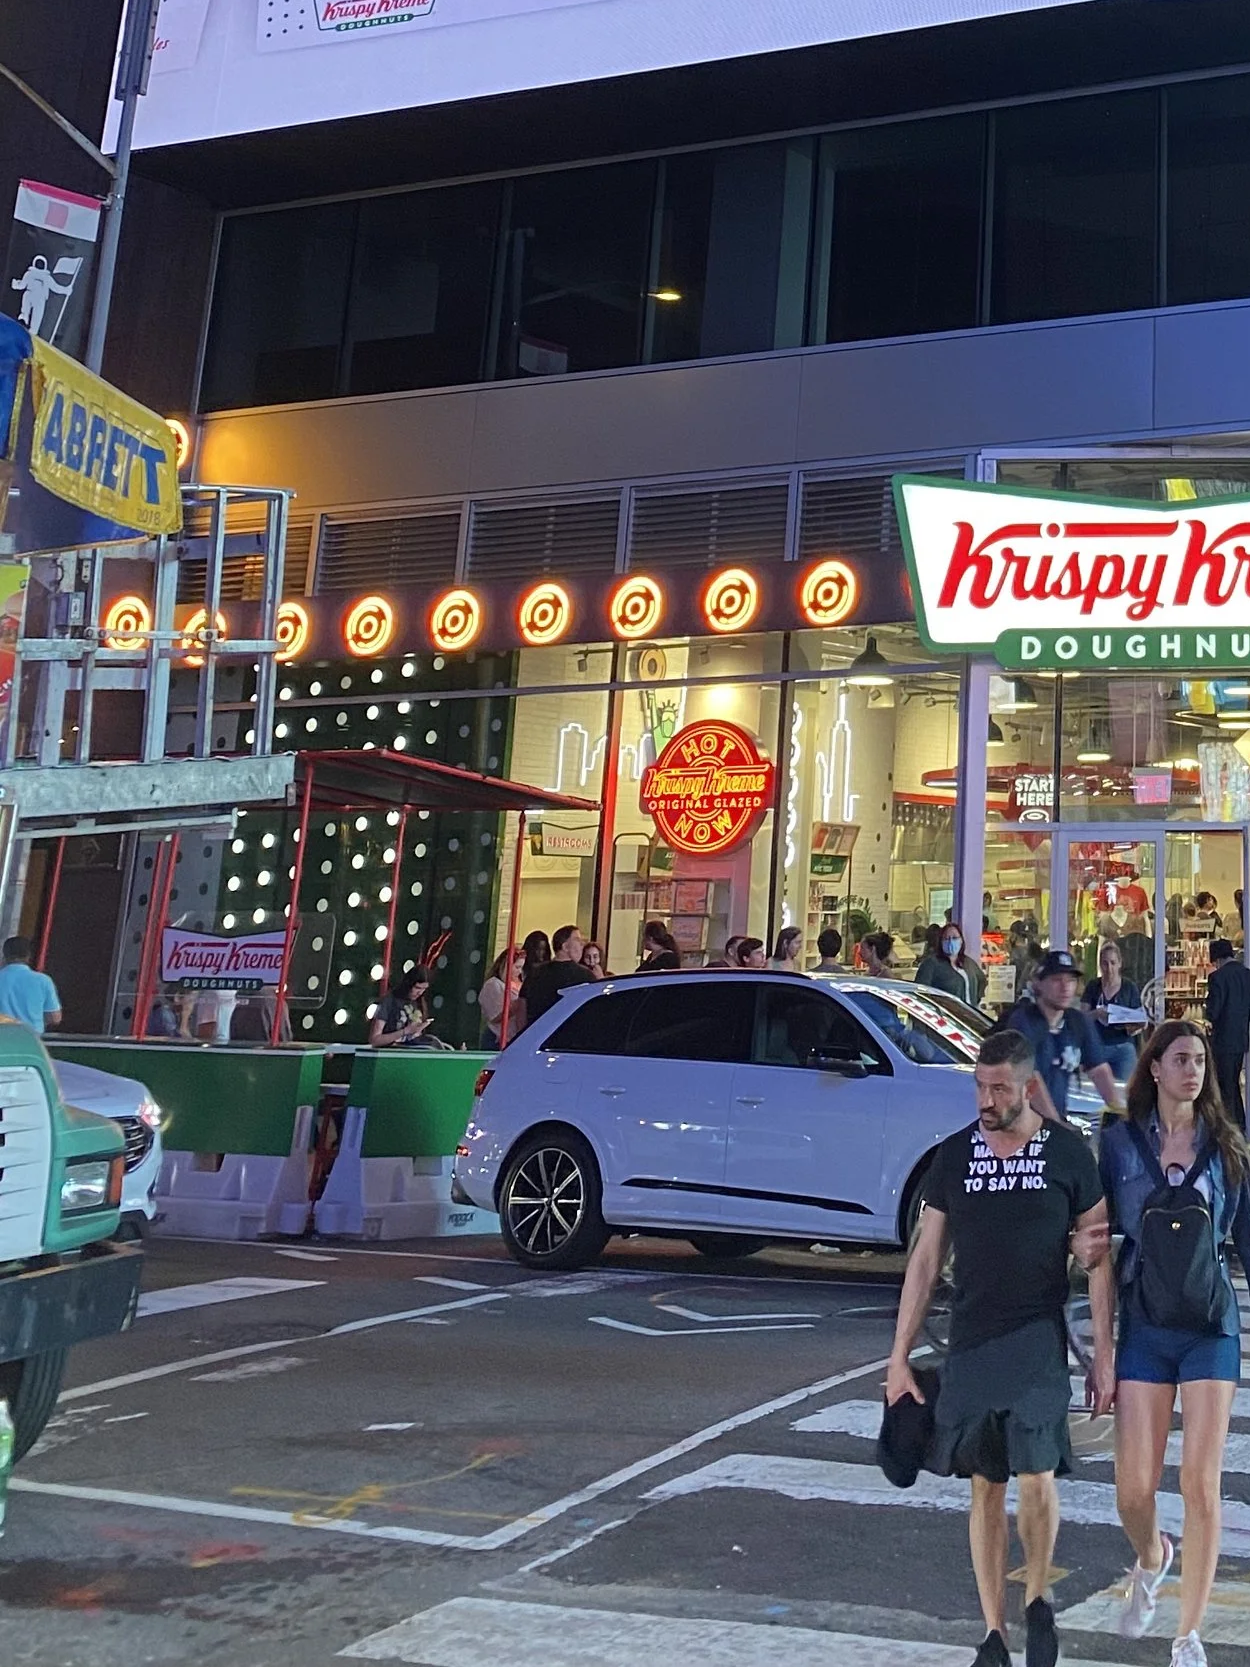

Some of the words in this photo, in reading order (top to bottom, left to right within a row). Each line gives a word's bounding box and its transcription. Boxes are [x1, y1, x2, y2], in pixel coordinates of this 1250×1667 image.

[339, 14, 410, 31] DOUGHNUTS
[152, 37, 171, 52] les
[937, 518, 1180, 622] Krispy
[680, 733, 736, 764] HOT
[643, 765, 711, 801] Krispy
[704, 763, 770, 796] Kreme
[1014, 778, 1055, 793] START
[648, 799, 710, 811] ORIGINAL
[713, 796, 762, 809] GLAZED
[1016, 792, 1054, 807] HERE
[673, 809, 733, 844] NOW
[166, 941, 231, 976] Krispy
[225, 941, 285, 971] Kreme
[183, 978, 258, 989] DOUGHNUTS
[1030, 1128, 1051, 1143] AY
[973, 1144, 1025, 1159] MAE
[1028, 1142, 1043, 1157] IF
[968, 1160, 998, 1176] YOU
[1001, 1159, 1047, 1175] WANT
[963, 1177, 983, 1193] TO
[987, 1175, 1018, 1192] SAY
[1021, 1175, 1048, 1191] NO.
